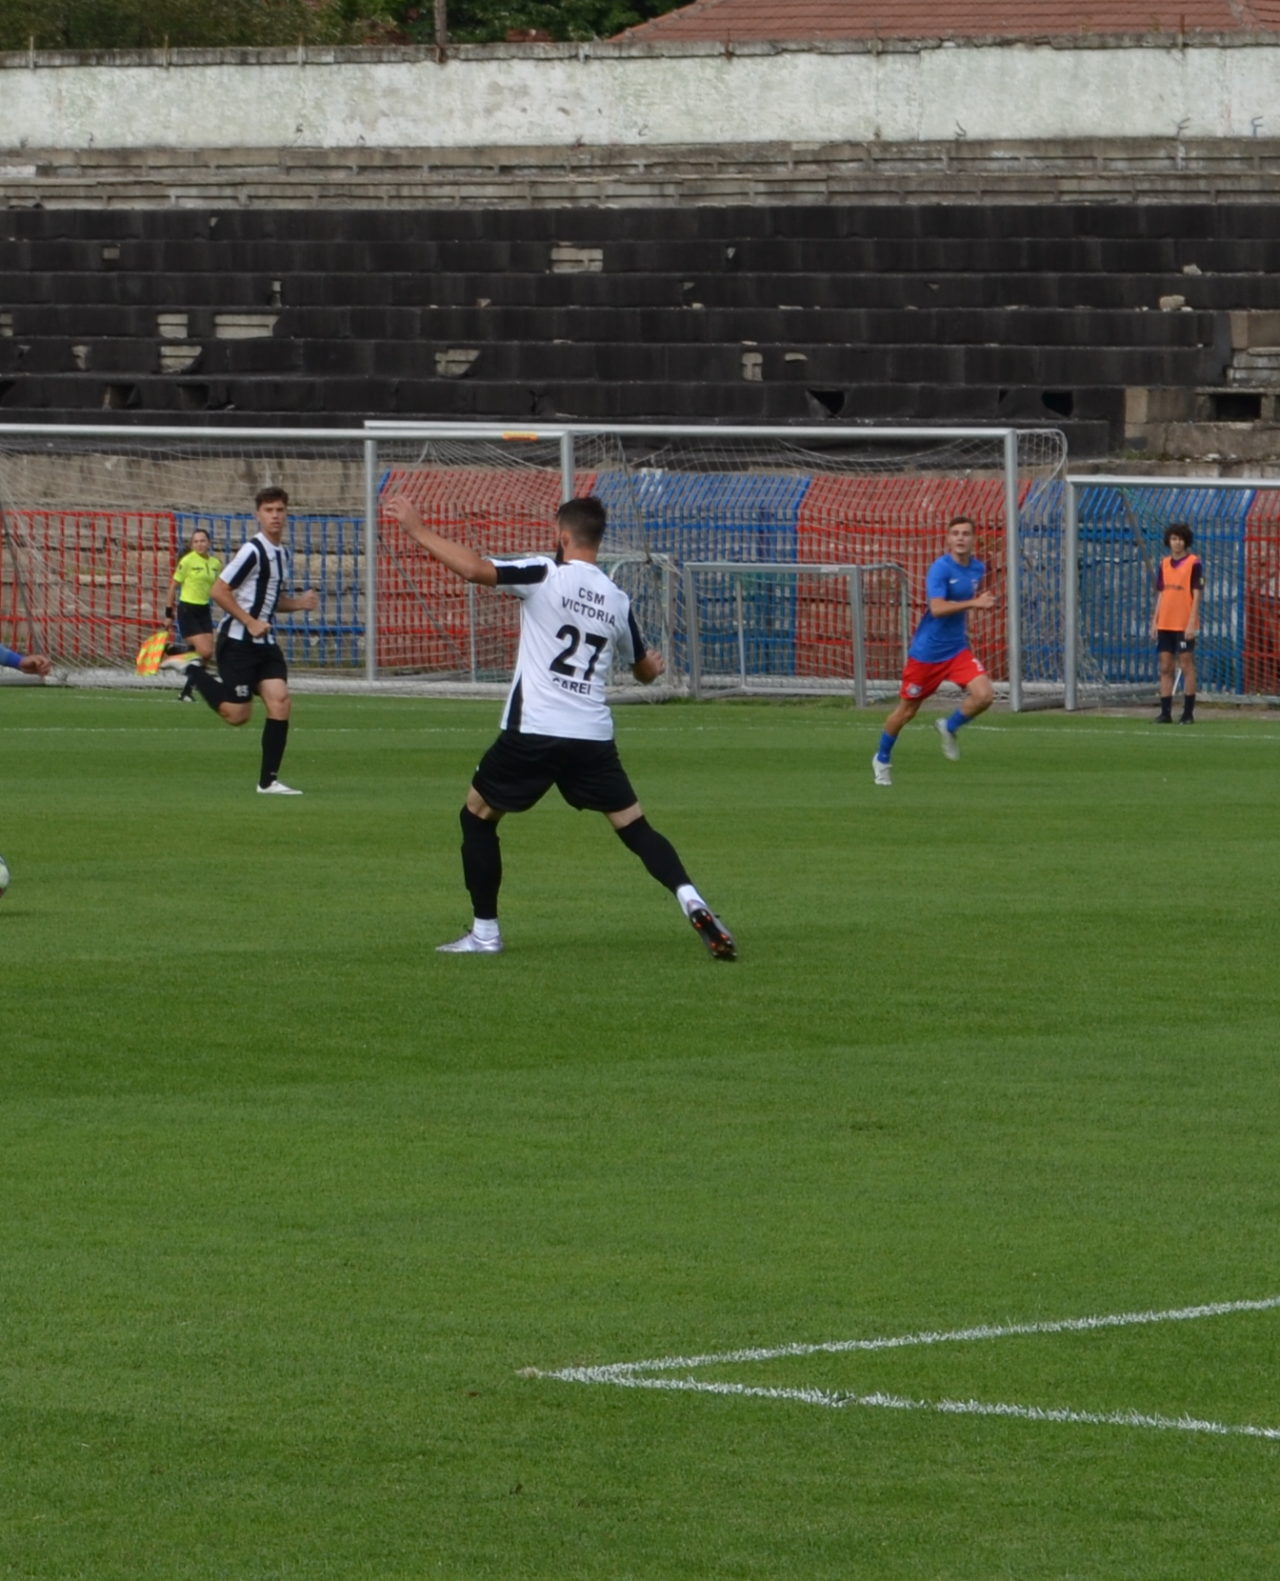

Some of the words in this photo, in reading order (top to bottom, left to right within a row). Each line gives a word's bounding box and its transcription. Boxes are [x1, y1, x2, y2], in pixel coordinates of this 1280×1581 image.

[561, 596, 616, 627] VICTORIA
[578, 586, 605, 606] CSM
[549, 624, 608, 681] 27
